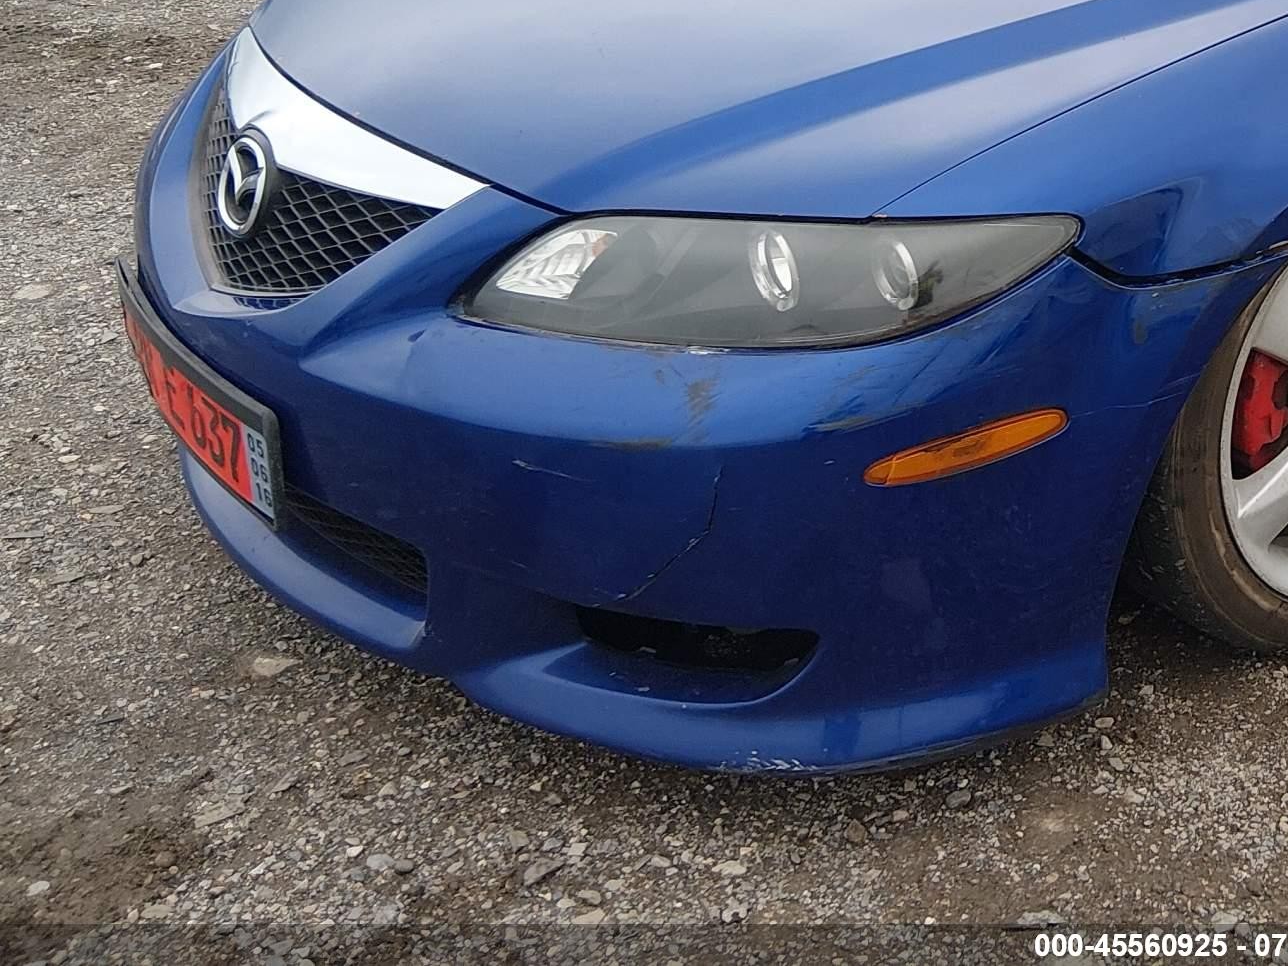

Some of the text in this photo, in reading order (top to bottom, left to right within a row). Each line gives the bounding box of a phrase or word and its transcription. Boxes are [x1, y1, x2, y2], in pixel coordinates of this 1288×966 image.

[247, 432, 265, 458] 05
[250, 458, 268, 482] 06
[255, 482, 273, 508] 16
